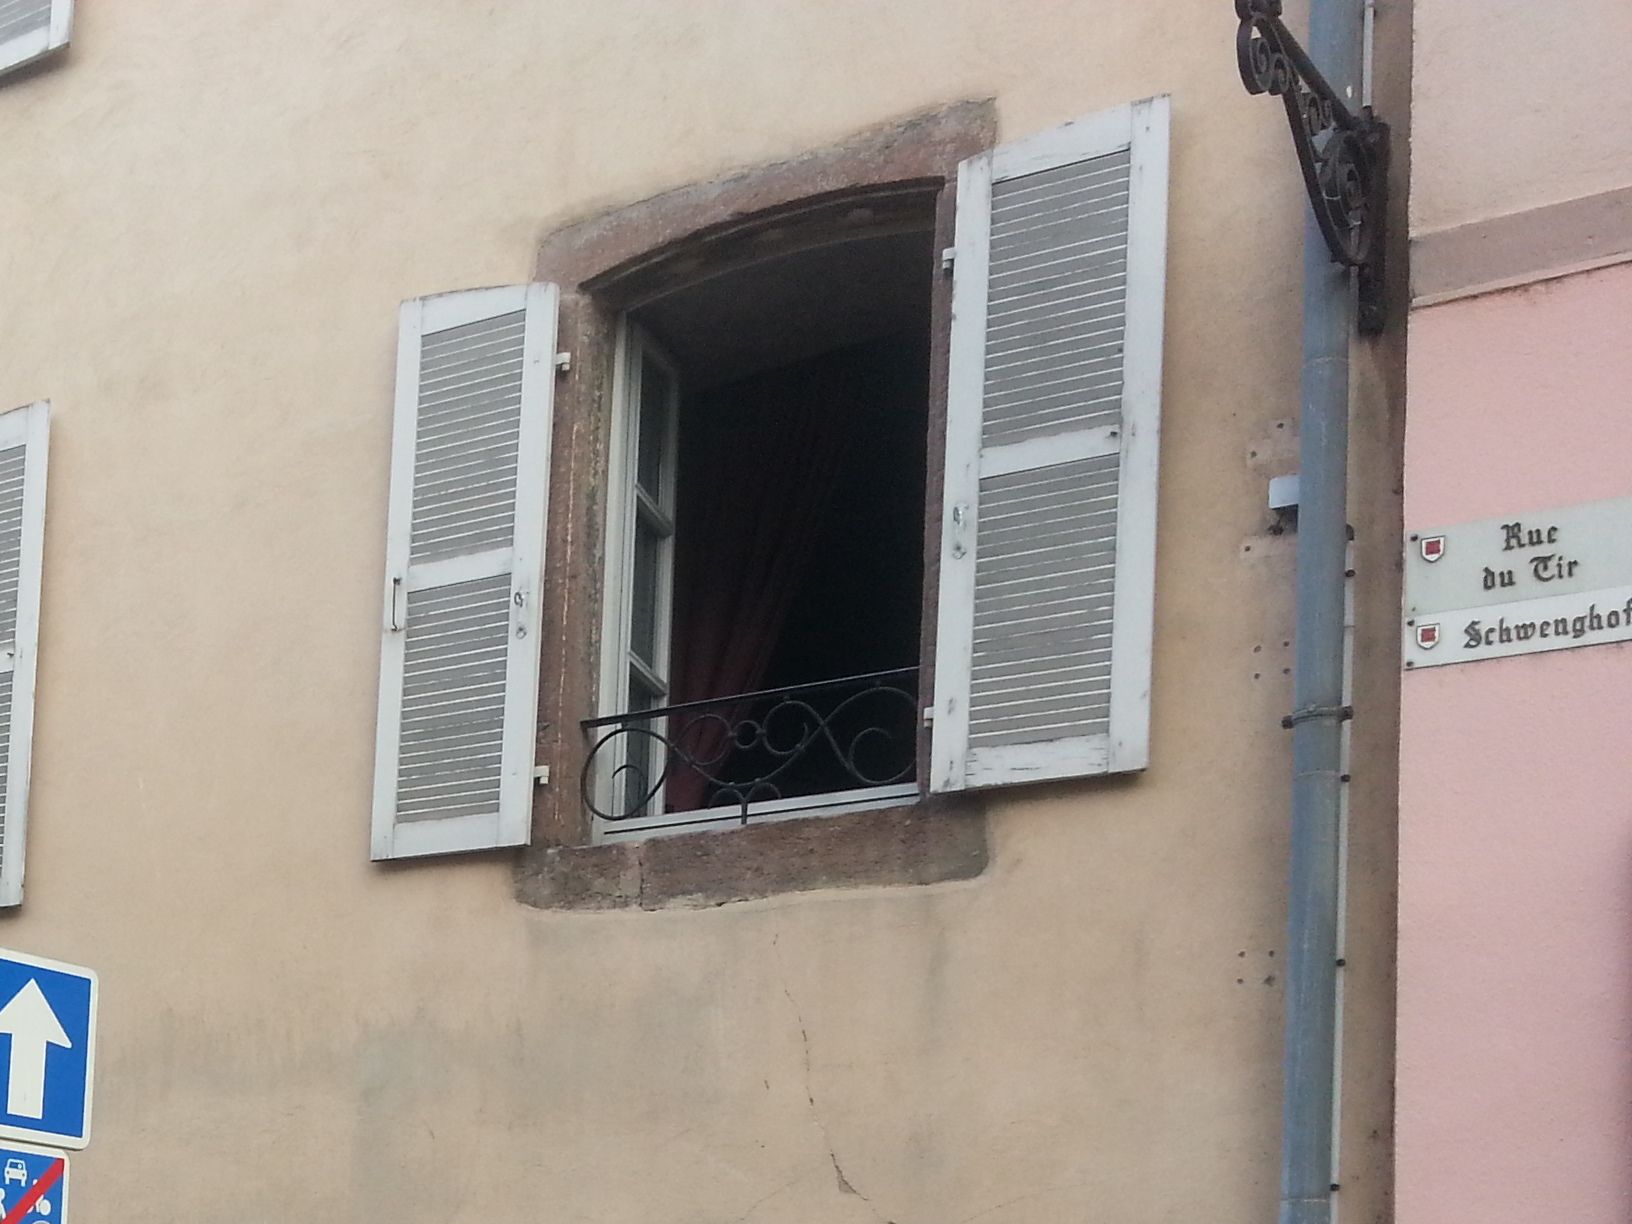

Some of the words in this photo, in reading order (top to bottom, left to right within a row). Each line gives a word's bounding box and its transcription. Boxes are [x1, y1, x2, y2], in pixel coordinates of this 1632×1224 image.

[1500, 522, 1558, 551] Rue
[1483, 567, 1515, 590] du
[1529, 553, 1578, 582] Tir
